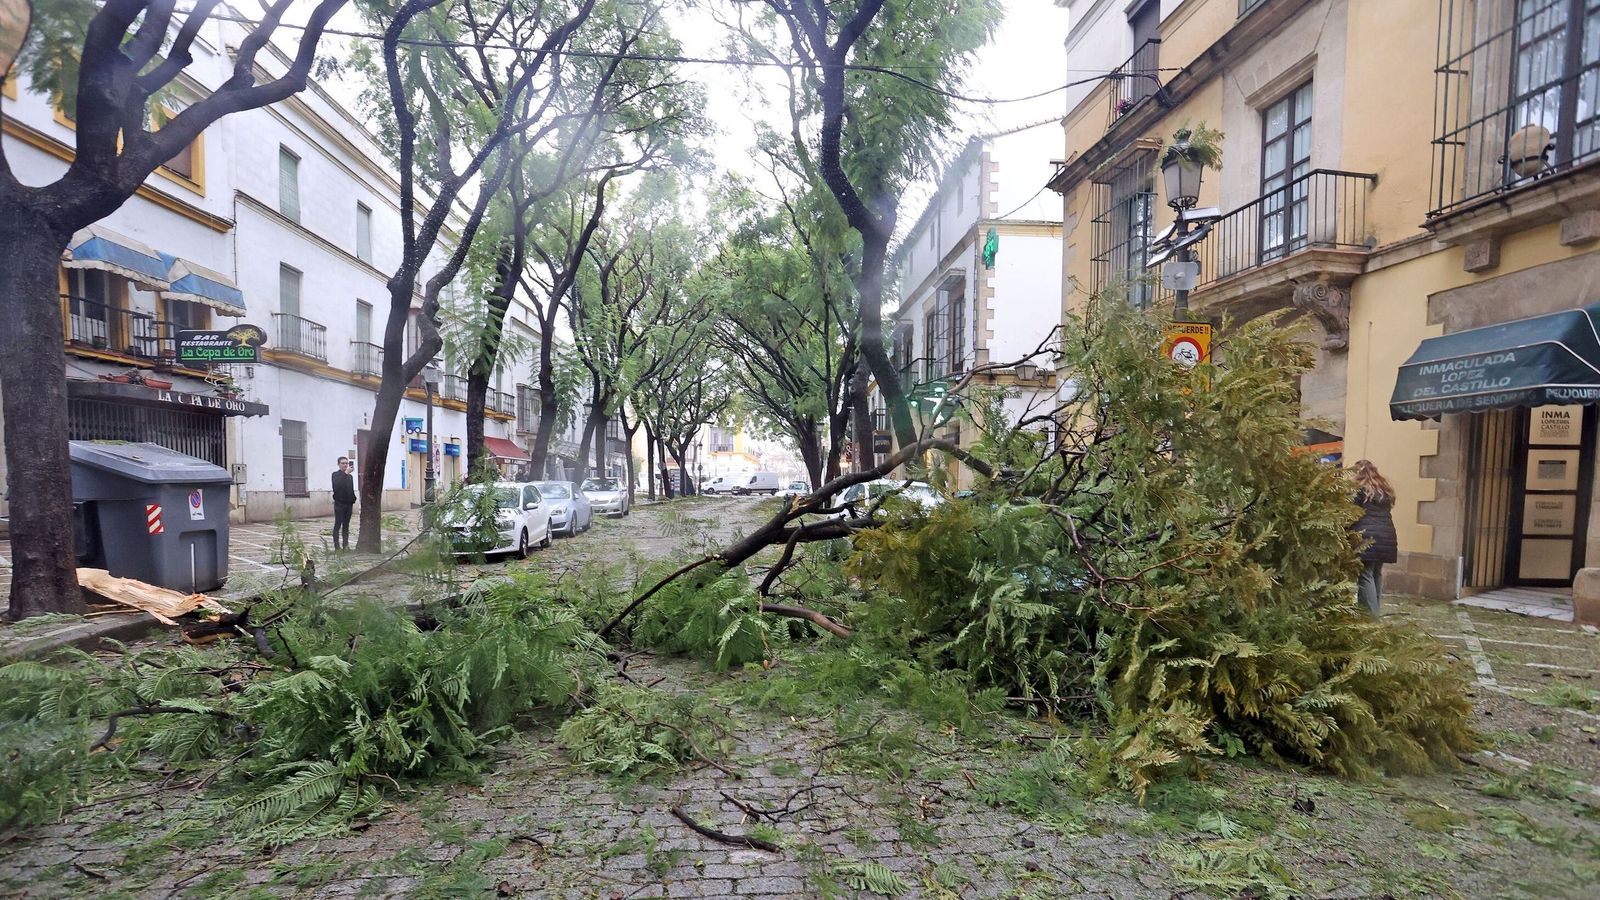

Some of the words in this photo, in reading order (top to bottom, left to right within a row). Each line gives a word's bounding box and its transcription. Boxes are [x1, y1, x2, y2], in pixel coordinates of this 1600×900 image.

[181, 347, 194, 357] La
[196, 347, 220, 360] Cepa
[223, 347, 236, 357] de
[238, 346, 254, 357] Oro
[1419, 352, 1516, 376] INMACULADA
[1441, 368, 1486, 383] LOPEZ
[1413, 386, 1437, 397] DEL
[1441, 376, 1511, 394] CASTILLO
[158, 390, 172, 402] LA
[178, 394, 203, 406] CPA
[207, 398, 222, 409] DE
[225, 400, 246, 412] ORO
[1456, 398, 1472, 407] DE
[1541, 411, 1570, 419] INMA
